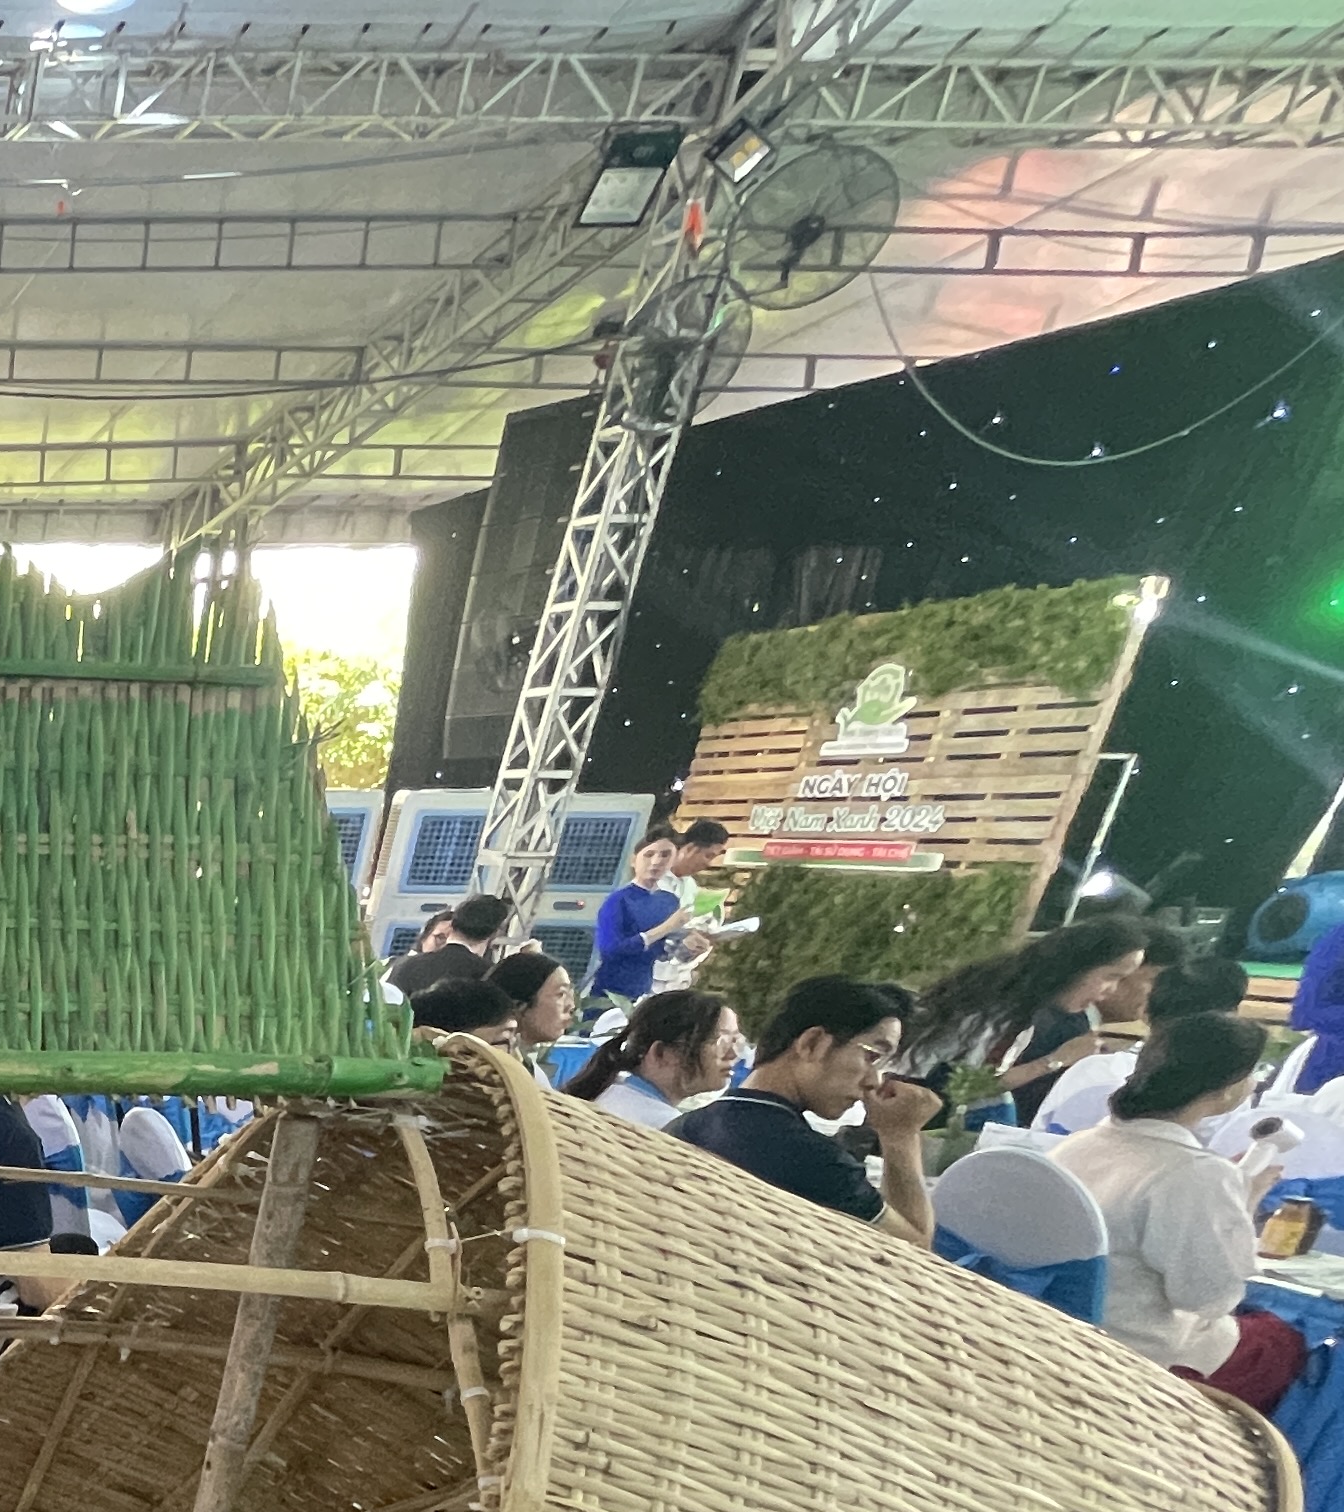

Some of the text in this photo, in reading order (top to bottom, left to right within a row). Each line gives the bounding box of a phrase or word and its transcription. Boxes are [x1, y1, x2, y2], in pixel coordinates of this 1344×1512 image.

[801, 769, 905, 797] NGÀY HỘI
[883, 807, 944, 829] 2024
